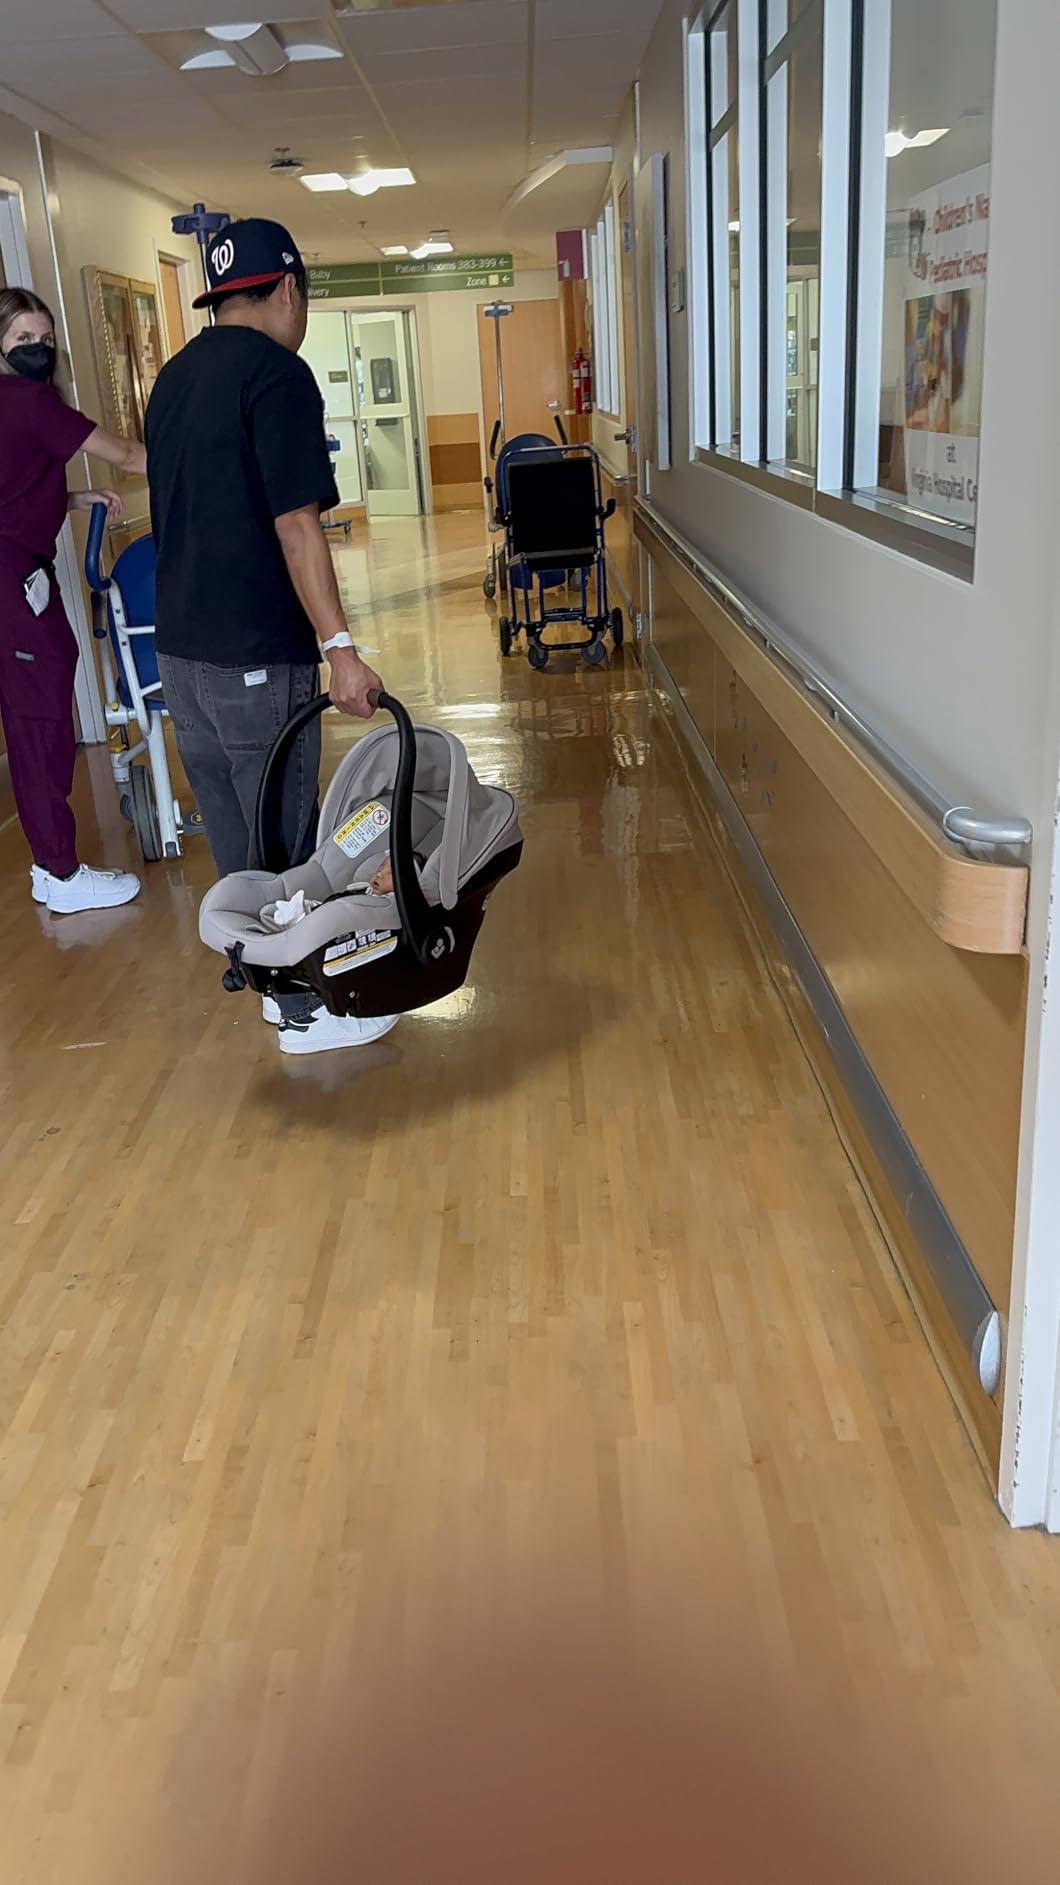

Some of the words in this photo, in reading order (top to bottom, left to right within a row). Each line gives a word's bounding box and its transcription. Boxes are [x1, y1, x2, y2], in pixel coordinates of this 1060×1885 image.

[211, 238, 234, 276] W
[394, 263, 425, 274] Patient
[427, 261, 457, 272] Rooms
[458, 258, 497, 270] 383-399
[309, 269, 331, 280] Baby
[466, 276, 487, 287] Zone
[933, 472, 965, 503] Hospital
